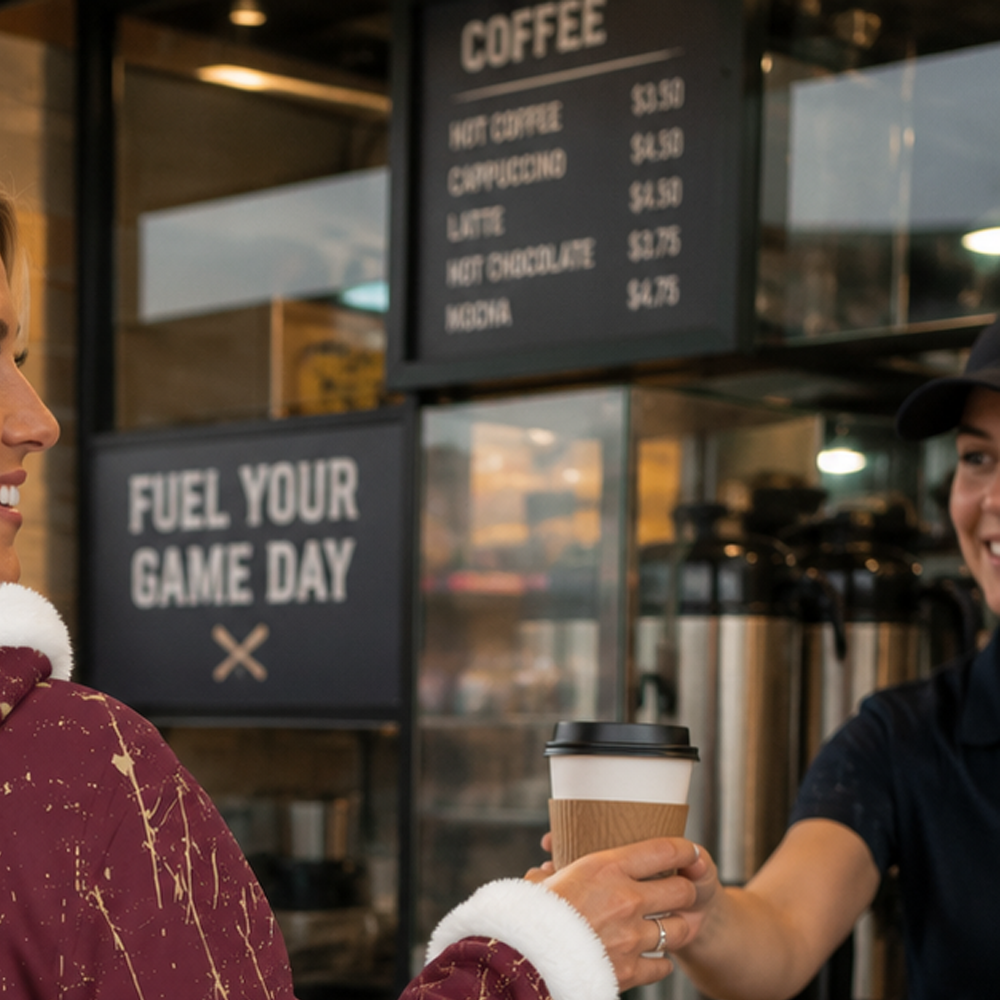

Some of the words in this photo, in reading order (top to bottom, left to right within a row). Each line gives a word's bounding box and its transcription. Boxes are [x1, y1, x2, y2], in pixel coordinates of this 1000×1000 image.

[461, 0, 607, 72] COFFEE
[449, 114, 487, 151] HOT
[490, 100, 563, 143] COFFEE
[448, 148, 567, 196] CAPPUCCINO
[447, 205, 505, 242] LATTE
[446, 254, 483, 288] HOT
[486, 237, 595, 283] CHOCOLATE
[445, 298, 512, 333] MOCHA
[128, 467, 230, 535] FUEL
[239, 457, 359, 528] YOUR
[131, 541, 254, 609] GAME
[265, 537, 356, 605] DAY
